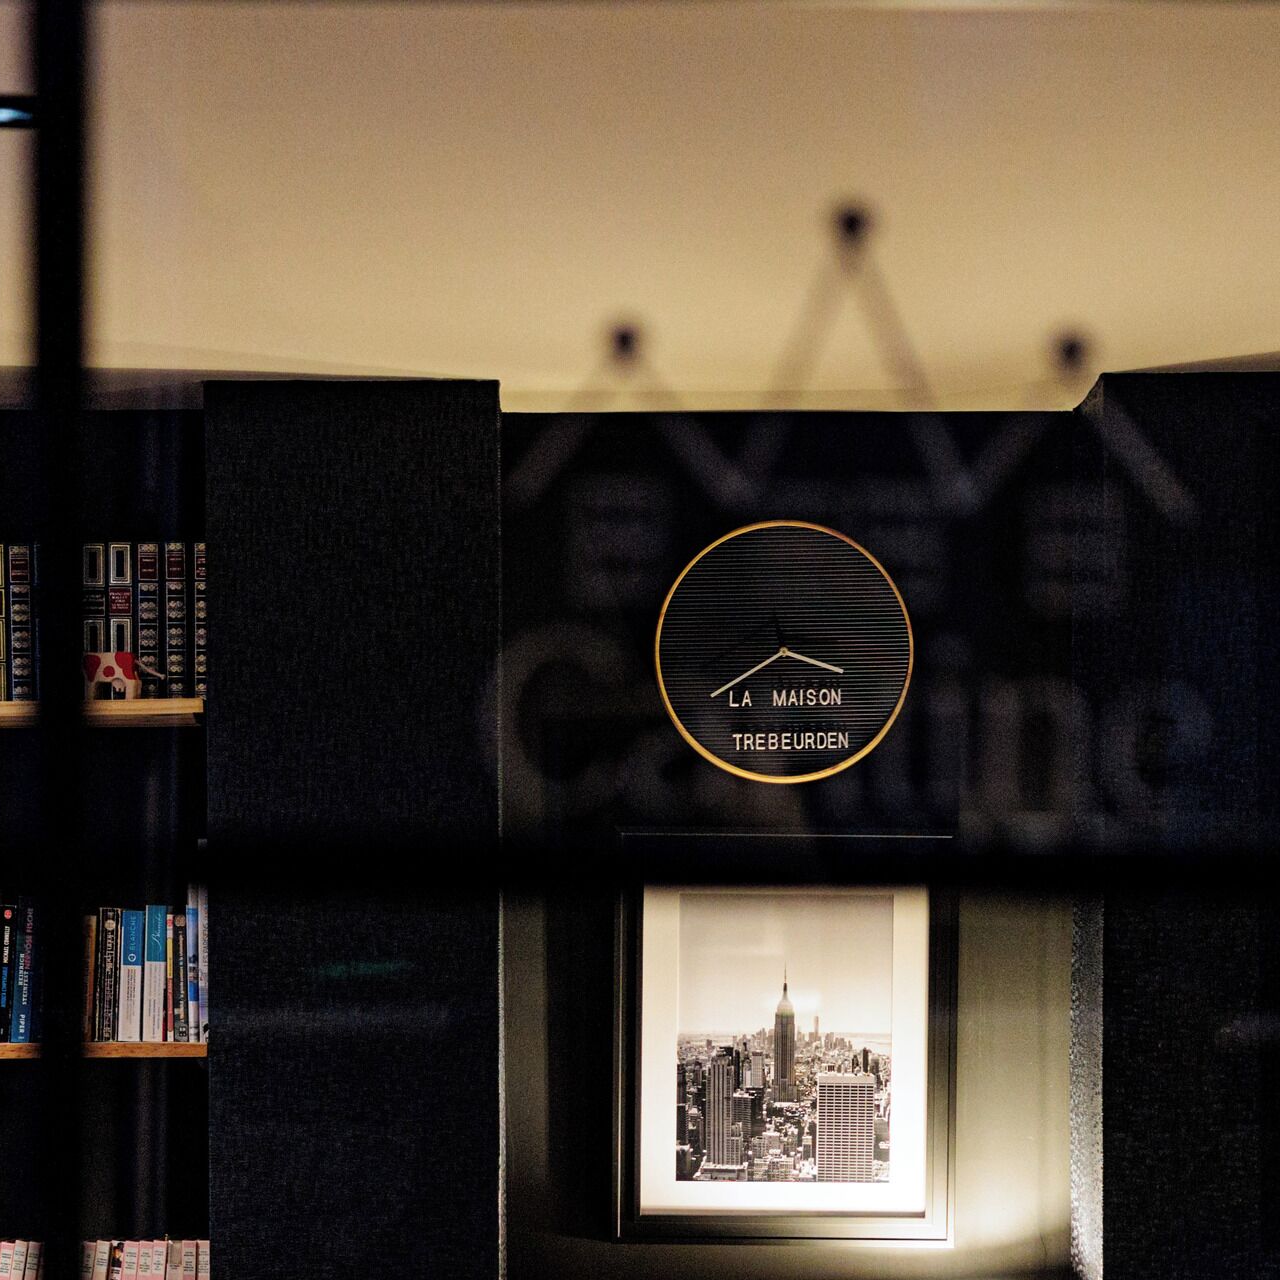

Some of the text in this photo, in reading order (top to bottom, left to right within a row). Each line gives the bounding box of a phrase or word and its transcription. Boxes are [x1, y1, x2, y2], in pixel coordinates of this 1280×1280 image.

[729, 688, 841, 707] LA MAISON
[732, 731, 849, 750] TREBEURDEN
[18, 1014, 26, 1033] PIPER
